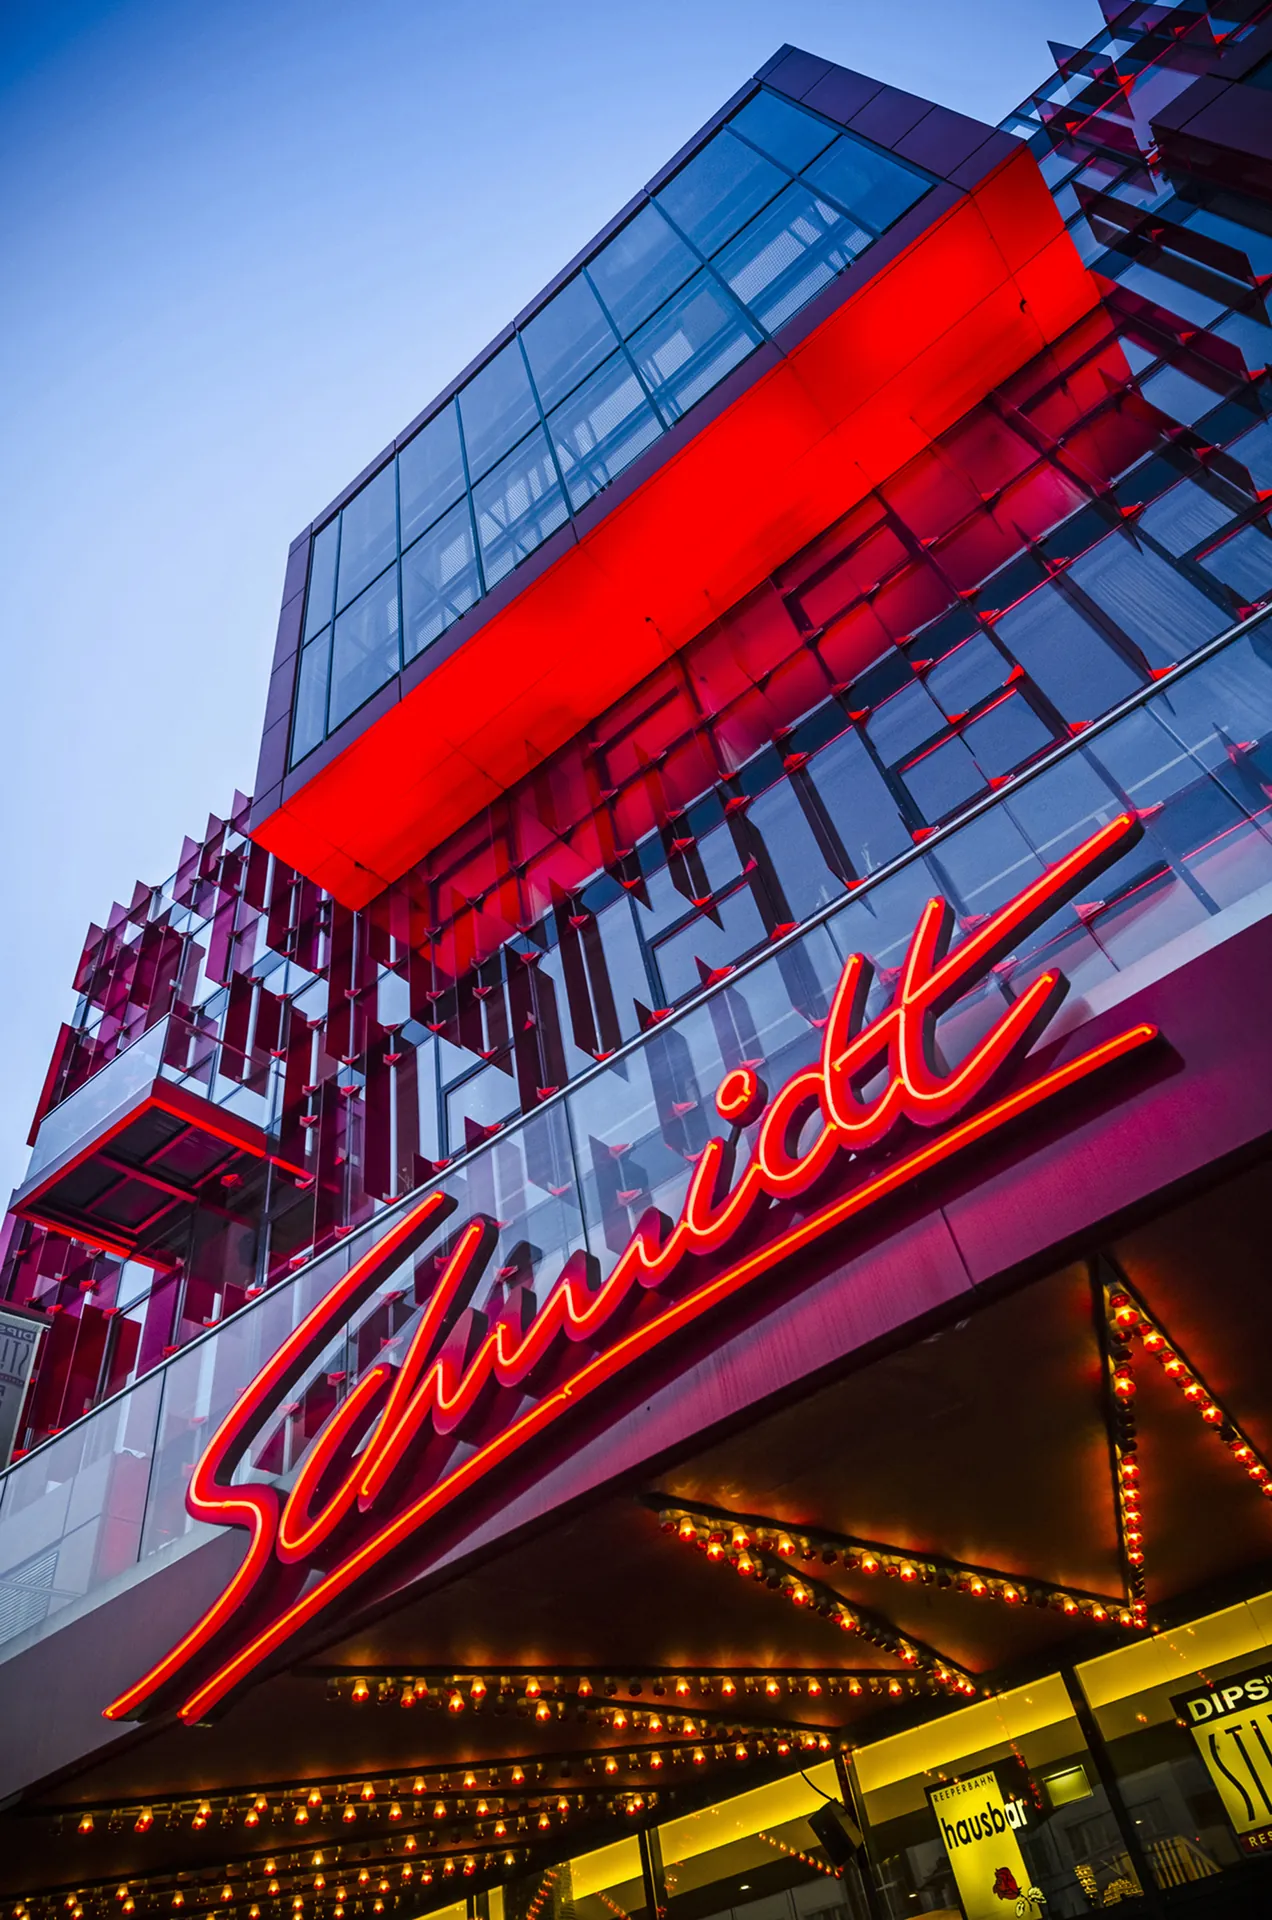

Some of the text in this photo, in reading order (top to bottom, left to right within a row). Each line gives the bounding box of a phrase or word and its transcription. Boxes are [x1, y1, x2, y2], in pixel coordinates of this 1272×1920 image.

[103, 811, 1142, 1720] Schmidt
[933, 1775, 994, 1802] REEPERBAHN
[941, 1799, 1028, 1849] hausbar
